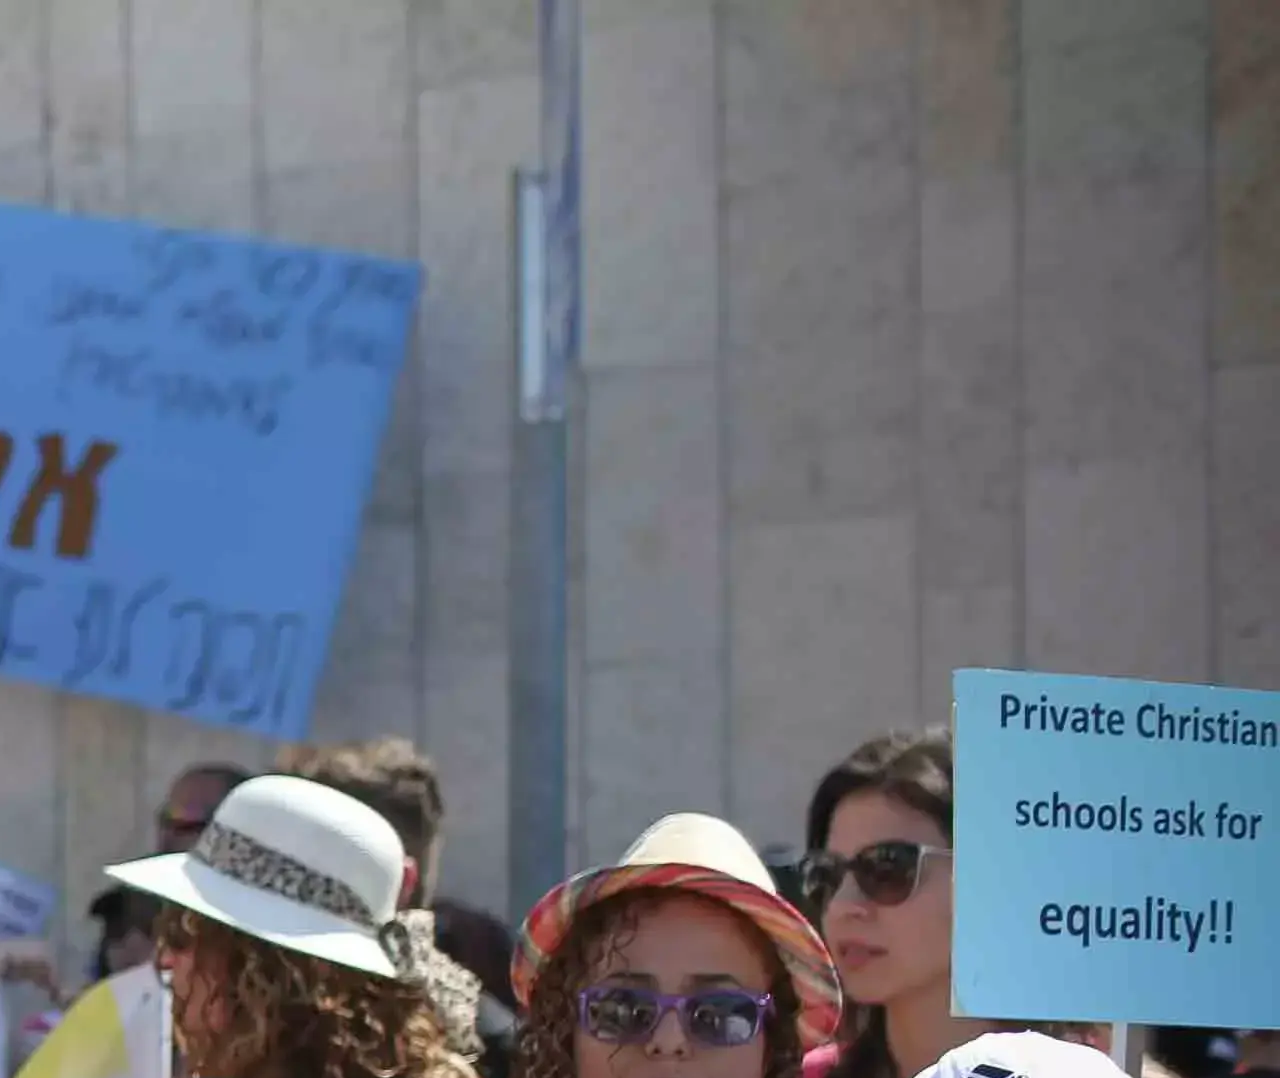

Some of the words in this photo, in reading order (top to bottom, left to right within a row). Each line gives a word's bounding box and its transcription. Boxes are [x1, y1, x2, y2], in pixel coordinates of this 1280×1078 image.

[999, 694, 1126, 737] Private
[1135, 703, 1278, 748] Christian
[1015, 791, 1143, 834] schools
[1152, 800, 1206, 838] ask
[1214, 802, 1263, 841] for
[1039, 895, 1234, 954] equality!!
